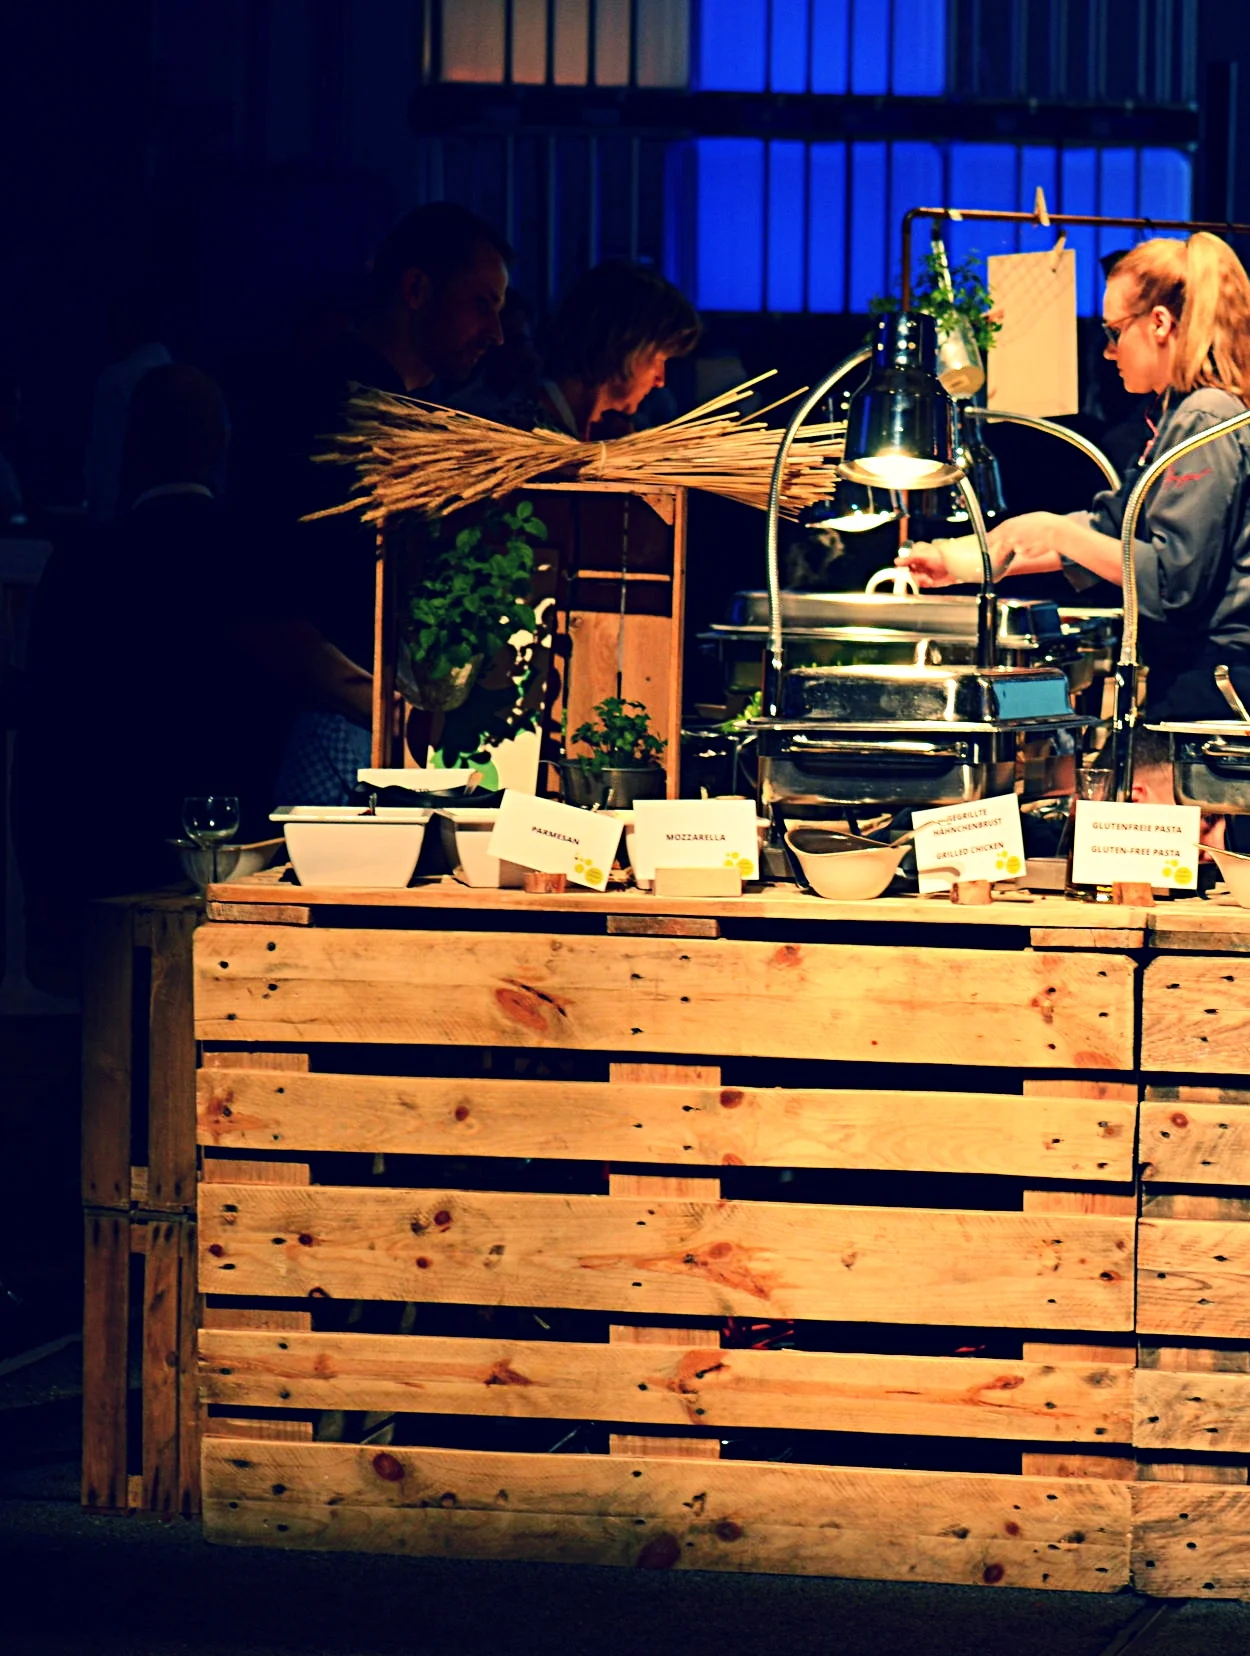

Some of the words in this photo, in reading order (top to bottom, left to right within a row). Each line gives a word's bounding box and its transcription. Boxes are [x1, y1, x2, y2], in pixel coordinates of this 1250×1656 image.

[1092, 822, 1152, 832] GLUTENFREIE
[1154, 825, 1182, 833] PASTA
[531, 825, 580, 846] PARMESAN
[665, 833, 726, 842] MOZZARELLA
[936, 848, 969, 860] GRILLED
[971, 841, 1004, 854] CHICKEN
[1091, 845, 1150, 856] GLUTEN-FREE
[1153, 849, 1180, 857] PASTA
